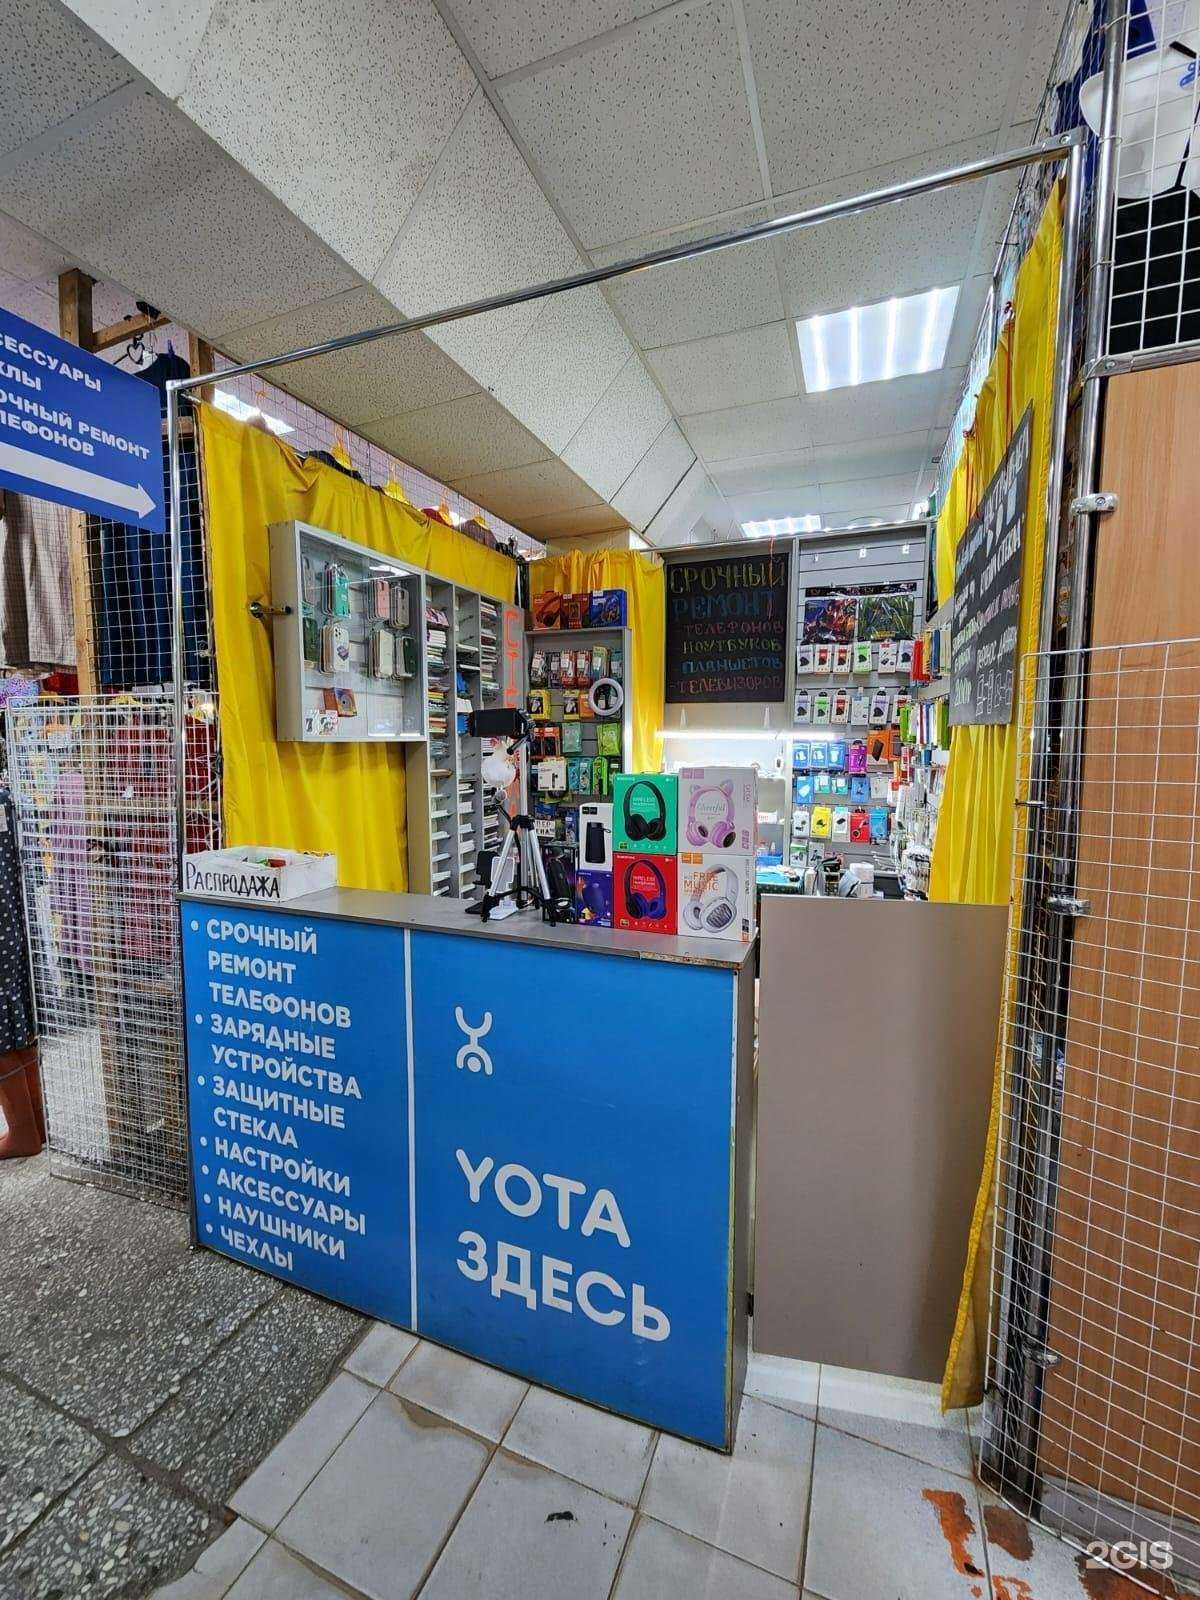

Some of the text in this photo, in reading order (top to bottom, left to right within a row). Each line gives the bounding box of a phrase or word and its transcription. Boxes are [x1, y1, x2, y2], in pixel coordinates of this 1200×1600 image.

[78, 421, 150, 460] РЕМОНТ
[670, 557, 785, 594] СРОЧНЫЙ
[672, 588, 775, 620] РЕМОНТ
[682, 638, 782, 654] НОУТБУКОВ
[684, 620, 784, 636] ТЕЛЕФОНОВ
[681, 656, 783, 674] ПЛАНШЕТОВ
[186, 861, 281, 898] РАСПРОДАЖА
[206, 919, 318, 955] СРОЧНЫЙ
[208, 951, 297, 984] РЕМОНТ
[209, 982, 352, 1028] ТЕЛЕФОНОВ
[210, 1014, 336, 1060] ЗАРЯДНЫЕ
[212, 1045, 362, 1099] УСТРОЙСТВА
[212, 1075, 345, 1129] ЗАЩИТНЫЕ
[213, 1107, 298, 1149] СТЕКЛА
[215, 1136, 351, 1197] НАСТРОЙКИ
[216, 1168, 366, 1235] АКСЕССУАРЫ
[456, 1149, 631, 1248] YOTA
[218, 1196, 345, 1260] НАУШНИКИ
[220, 1225, 293, 1271] ЧЕХЛЫ
[456, 1230, 671, 1342] ЗДЕСЬ
